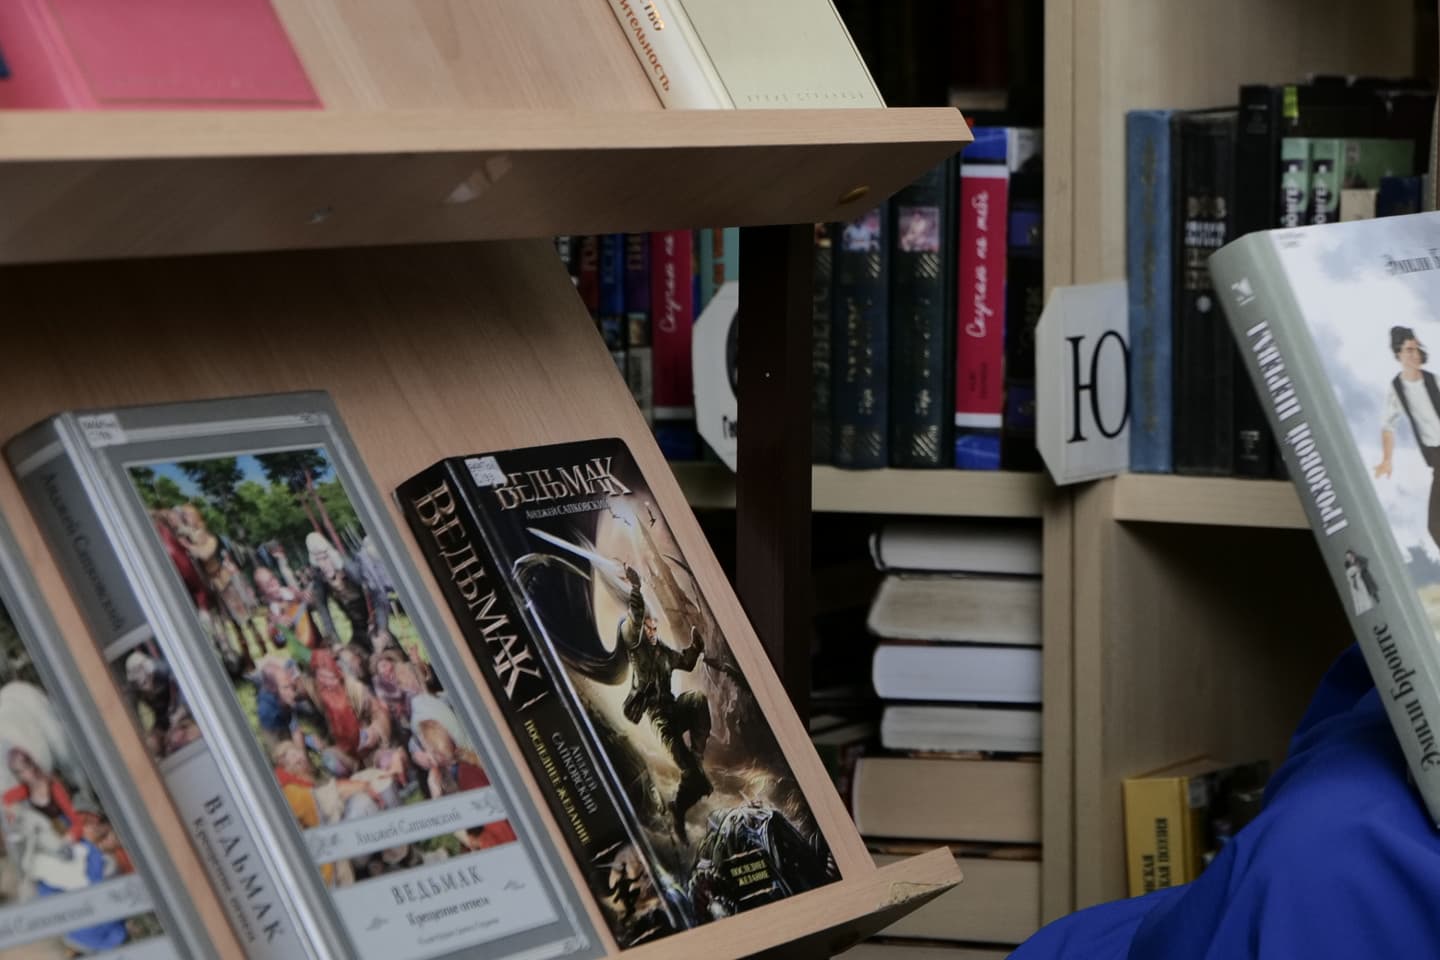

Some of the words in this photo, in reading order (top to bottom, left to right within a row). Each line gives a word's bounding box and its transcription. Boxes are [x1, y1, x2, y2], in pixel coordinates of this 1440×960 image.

[970, 190, 989, 231] тебе
[975, 236, 988, 259] по
[658, 262, 683, 334] Скучаю
[964, 265, 994, 338] Скучаю
[1066, 330, 1131, 443] Ю
[1246, 320, 1305, 423] ПЕРЕВАЛ
[495, 456, 633, 510] ВЕДЬМАК
[557, 498, 611, 515] САПКОВСКИЙ
[1285, 423, 1350, 538] ГРОЗОВОЙ
[413, 480, 541, 700] ВЕДЬМАК
[1373, 621, 1420, 701] Бронте
[523, 719, 561, 787] ПОСЛЕДНЕЕ
[556, 786, 590, 846] ЖЕЛАНИЕ
[552, 731, 598, 815] САПКОВСКИЙ
[570, 745, 598, 792] АНДЖЕЙ
[399, 809, 463, 835] Сапковский
[391, 864, 485, 906] ВЕДЬМАК
